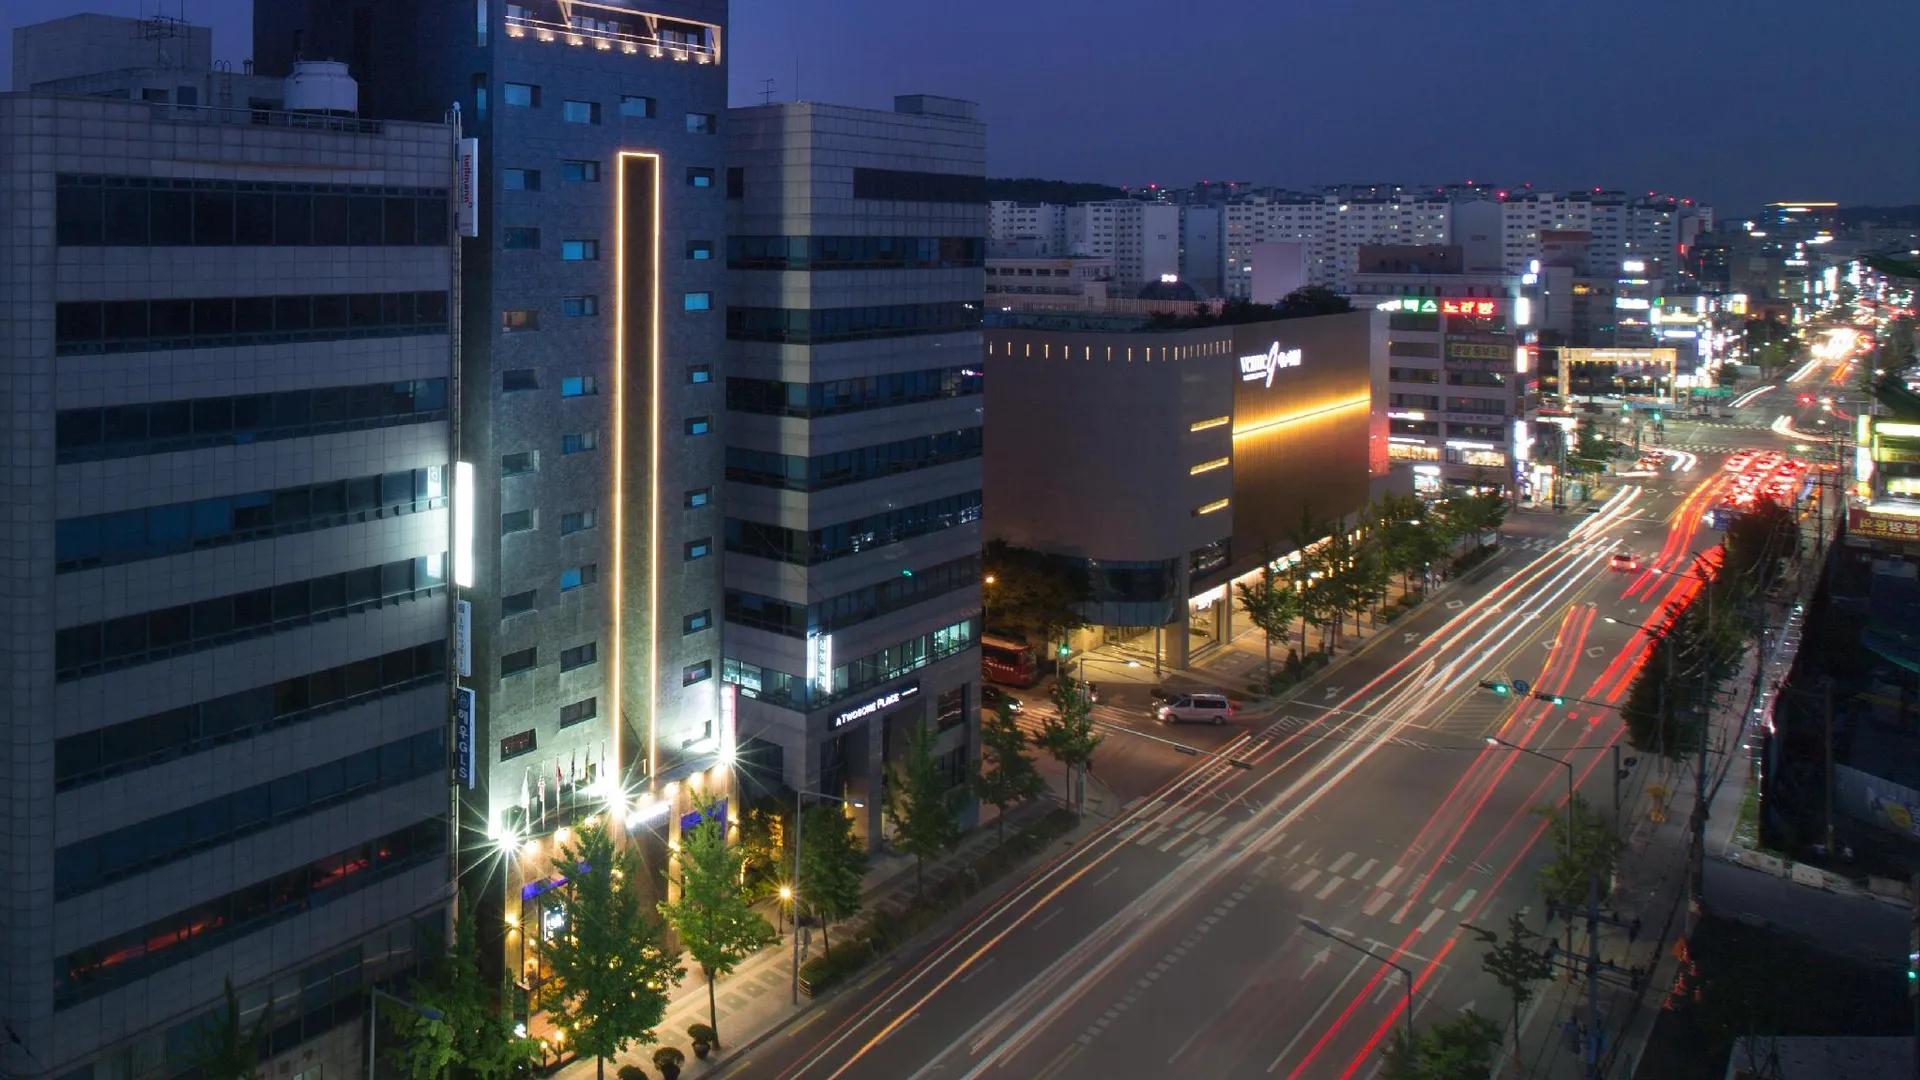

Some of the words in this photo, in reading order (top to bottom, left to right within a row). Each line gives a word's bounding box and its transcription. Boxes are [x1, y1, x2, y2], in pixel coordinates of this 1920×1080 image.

[463, 154, 472, 203] hellmann
[835, 717, 842, 727] A
[841, 702, 876, 723] TWOSOME
[877, 693, 899, 708] PLACE
